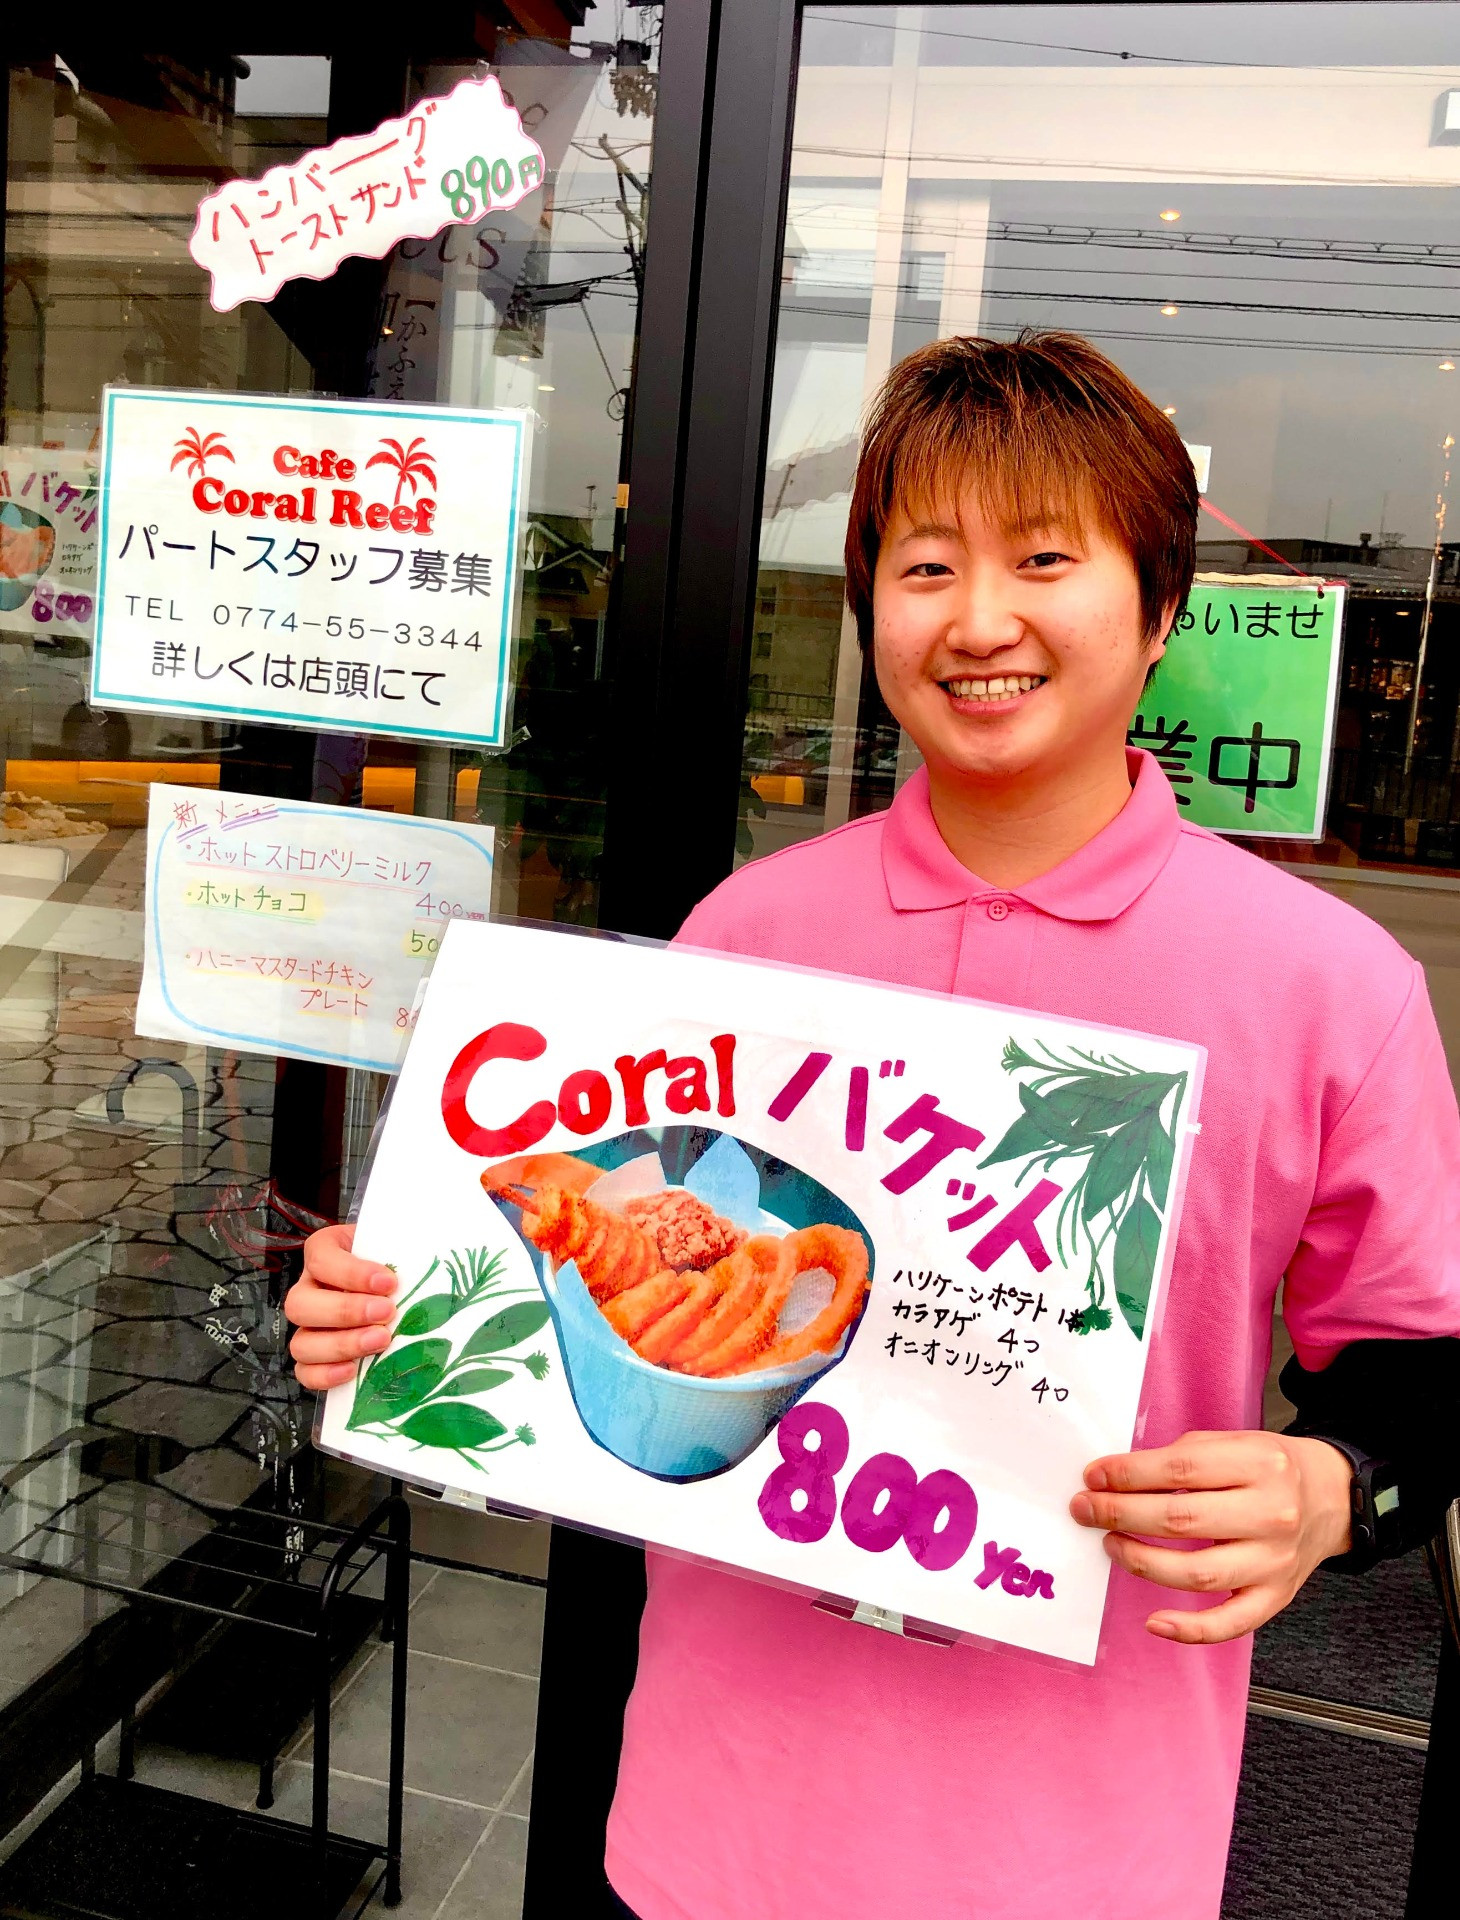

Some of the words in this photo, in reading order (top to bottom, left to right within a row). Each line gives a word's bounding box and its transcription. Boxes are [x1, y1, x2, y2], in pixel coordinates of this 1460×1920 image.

[211, 102, 439, 242] ハンバーグ
[248, 158, 427, 275] トーストサンド
[272, 445, 357, 482] Cafe
[192, 477, 317, 523] Coral
[329, 489, 437, 536] Reef
[118, 524, 492, 597] パートスタッフ募集
[31, 580, 92, 623] 800
[125, 594, 184, 622] TEL
[213, 604, 483, 653] 0774-55-3344
[151, 639, 446, 707] 詳しくは店頭にて
[300, 989, 369, 1016] プレート
[441, 1022, 737, 1158] Coral
[767, 1051, 1063, 1273] バケット
[892, 1300, 981, 1336] カラアゲ
[893, 1269, 1048, 1323] ハリケーンポテト
[884, 1333, 1024, 1387] オニオンリング
[757, 1401, 979, 1572] 800
